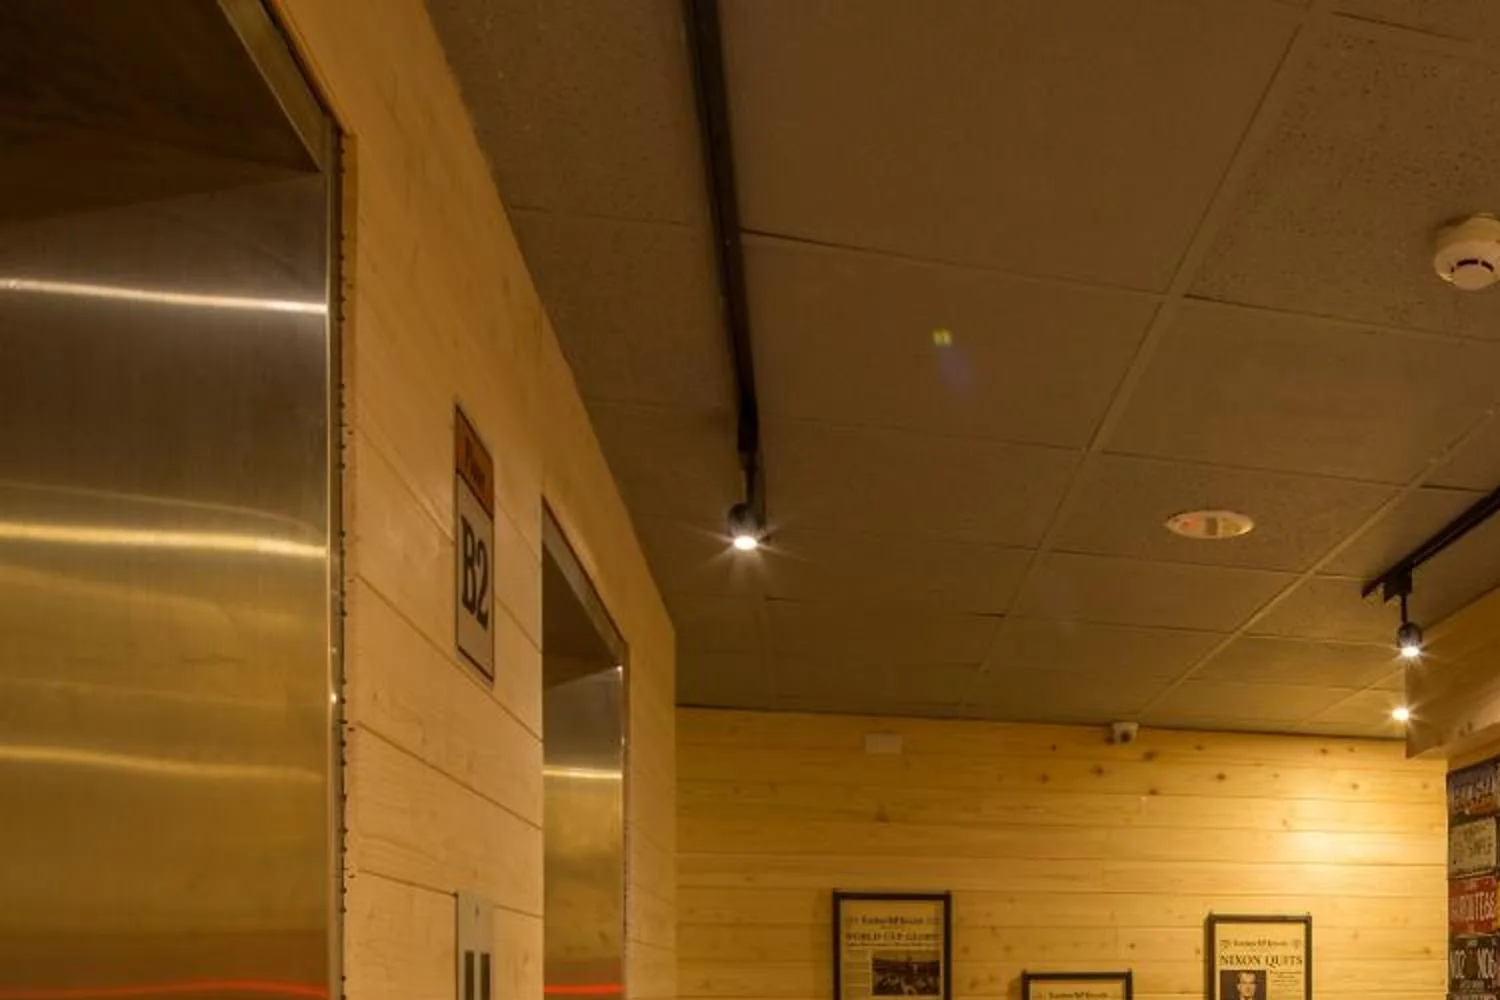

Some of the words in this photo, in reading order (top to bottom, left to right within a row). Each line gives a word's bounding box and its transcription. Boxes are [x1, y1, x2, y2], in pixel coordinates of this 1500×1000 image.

[462, 514, 488, 631] B2
[1219, 955, 1261, 965] NIXON
[1265, 955, 1303, 968] QUITS
